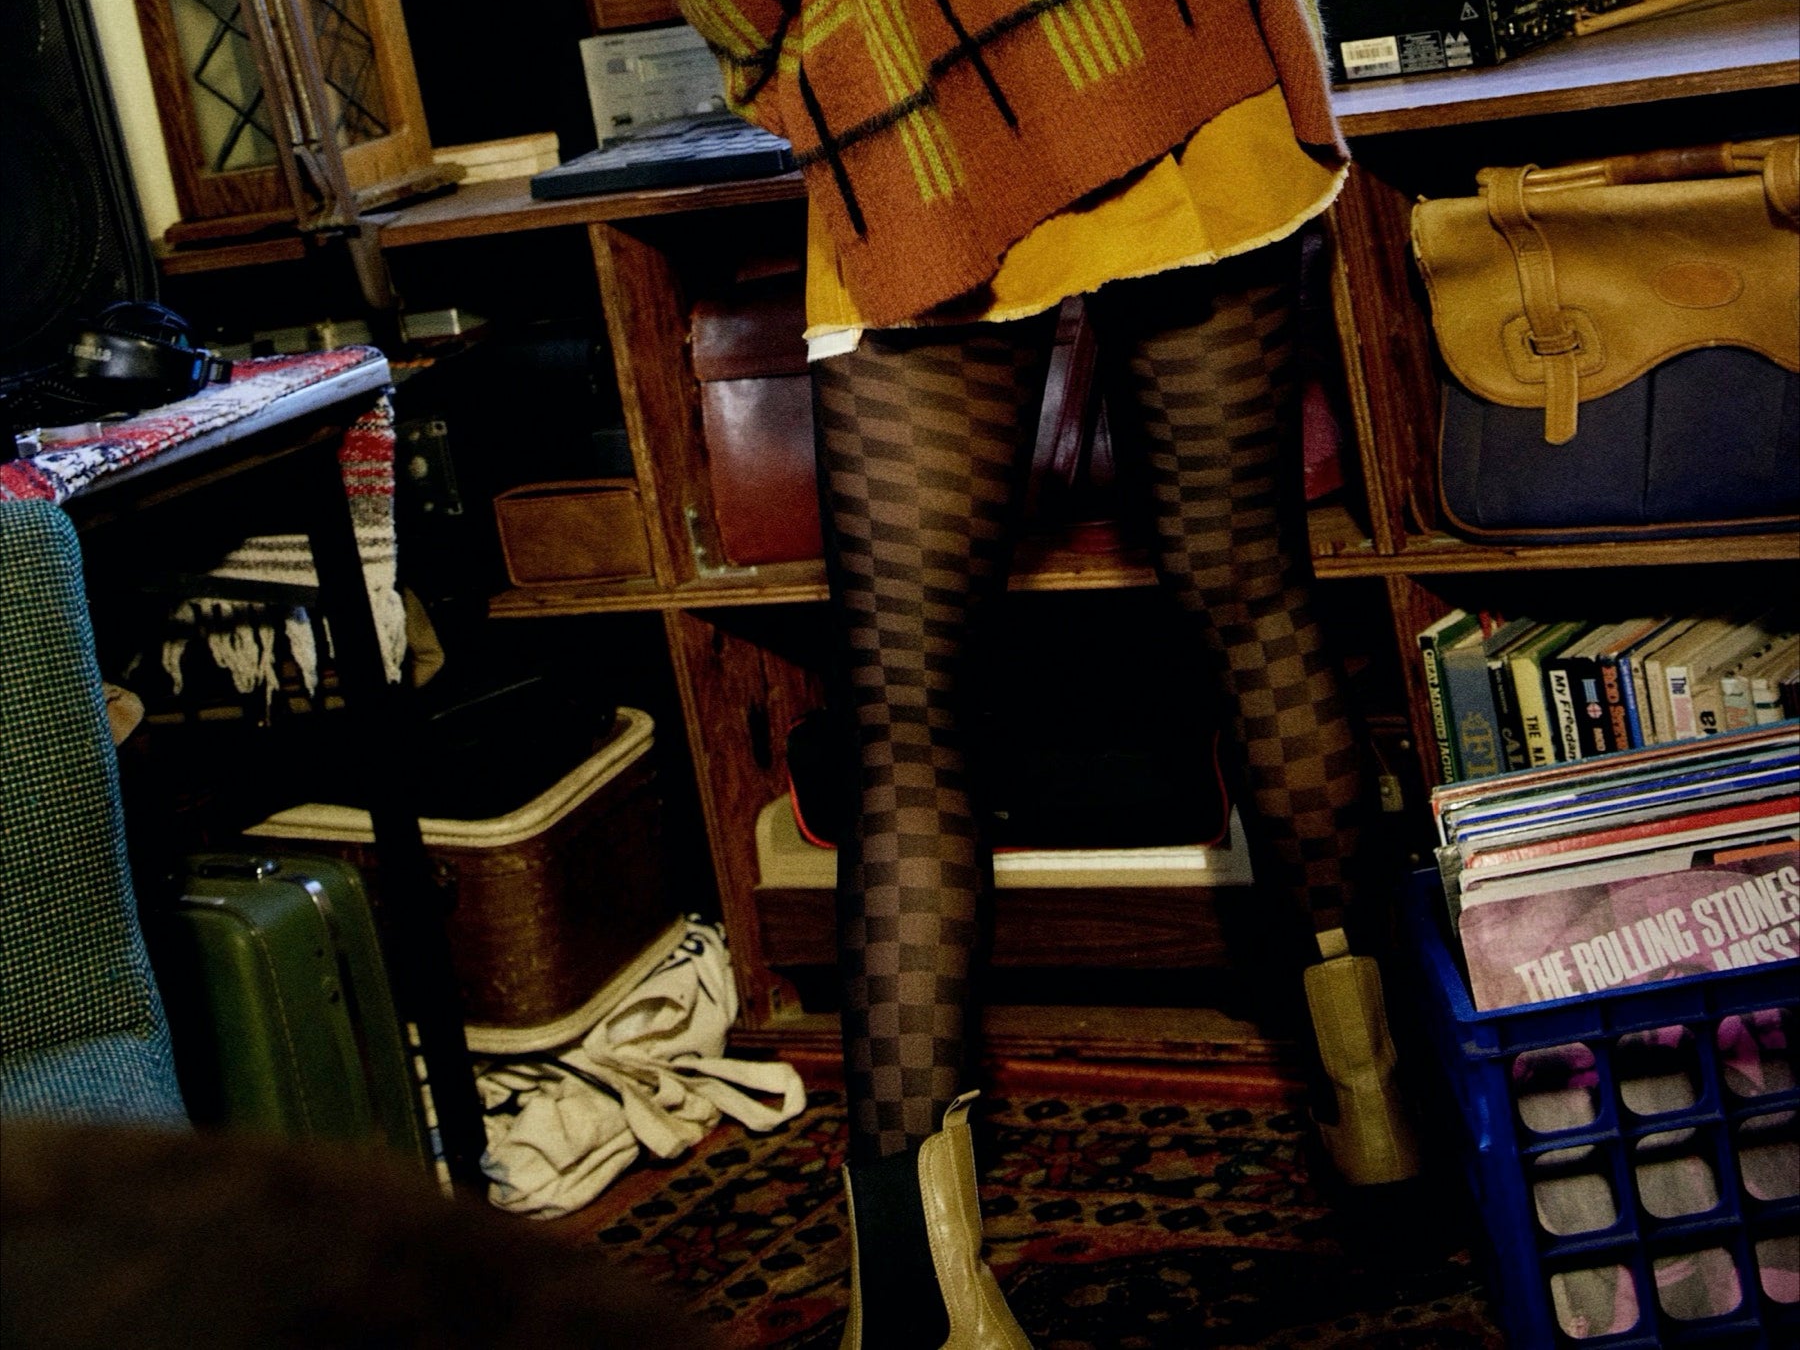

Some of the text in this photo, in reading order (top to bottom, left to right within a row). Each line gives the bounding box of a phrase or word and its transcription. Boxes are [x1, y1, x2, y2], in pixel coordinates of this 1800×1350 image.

[1422, 648, 1438, 685] GREAT
[1552, 673, 1567, 697] My
[1670, 676, 1687, 695] The
[1428, 685, 1447, 739] MARQUES
[1525, 715, 1541, 738] THE
[1513, 950, 1581, 1003] THE
[1570, 906, 1700, 993] ROLLING
[1691, 865, 1800, 948] STONES
